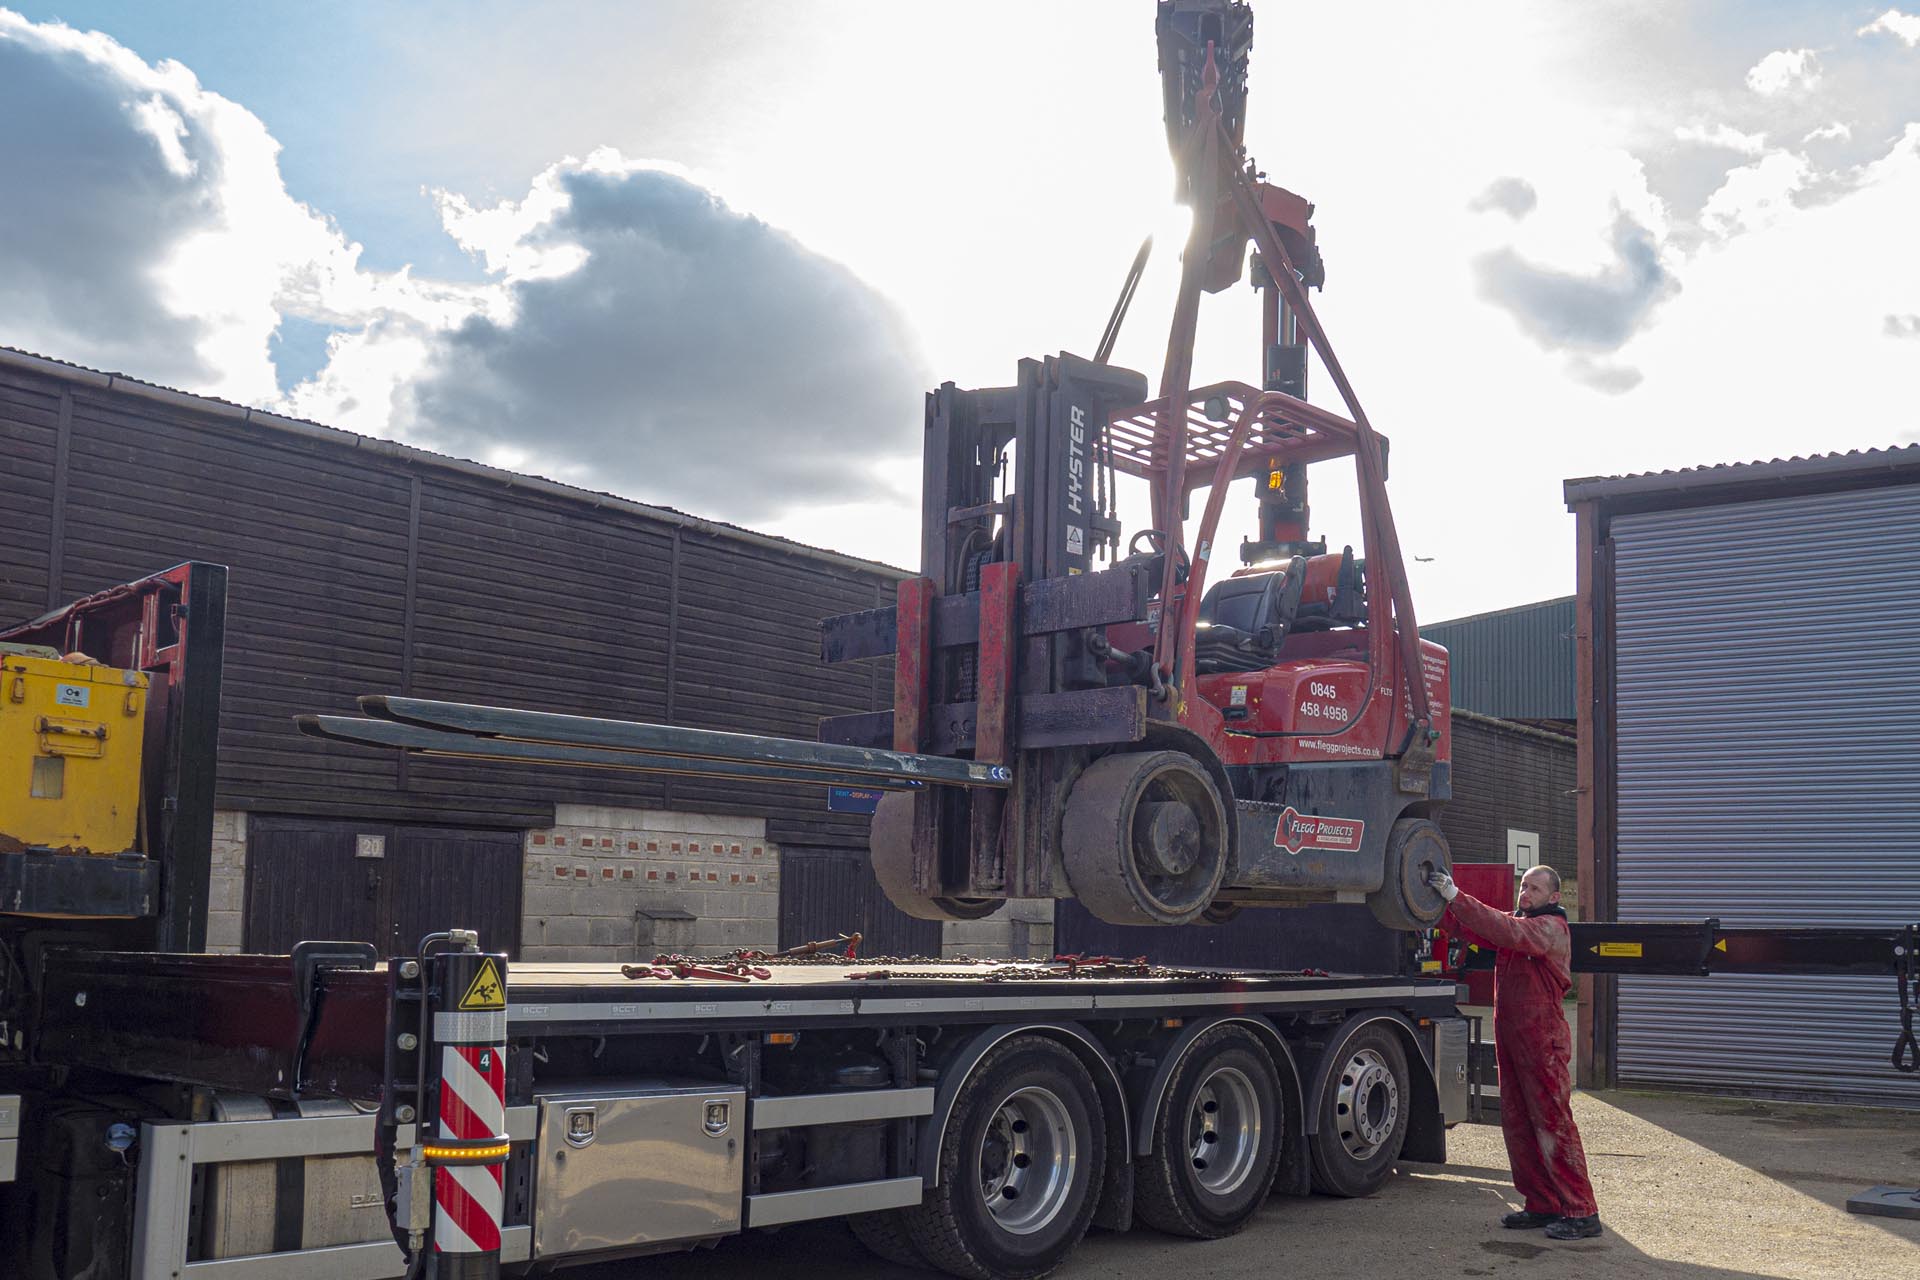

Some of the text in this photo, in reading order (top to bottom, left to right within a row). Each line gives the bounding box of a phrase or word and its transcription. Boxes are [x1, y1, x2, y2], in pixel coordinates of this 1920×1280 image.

[1068, 405, 1085, 515] HYSTER
[1310, 682, 1336, 699] 0845
[1300, 701, 1348, 722] 458 4958
[1299, 739, 1380, 757] www.fleggprojects.co.uk
[1291, 820, 1354, 837] FLEGG PROJECTS
[480, 1053, 490, 1067] 4
